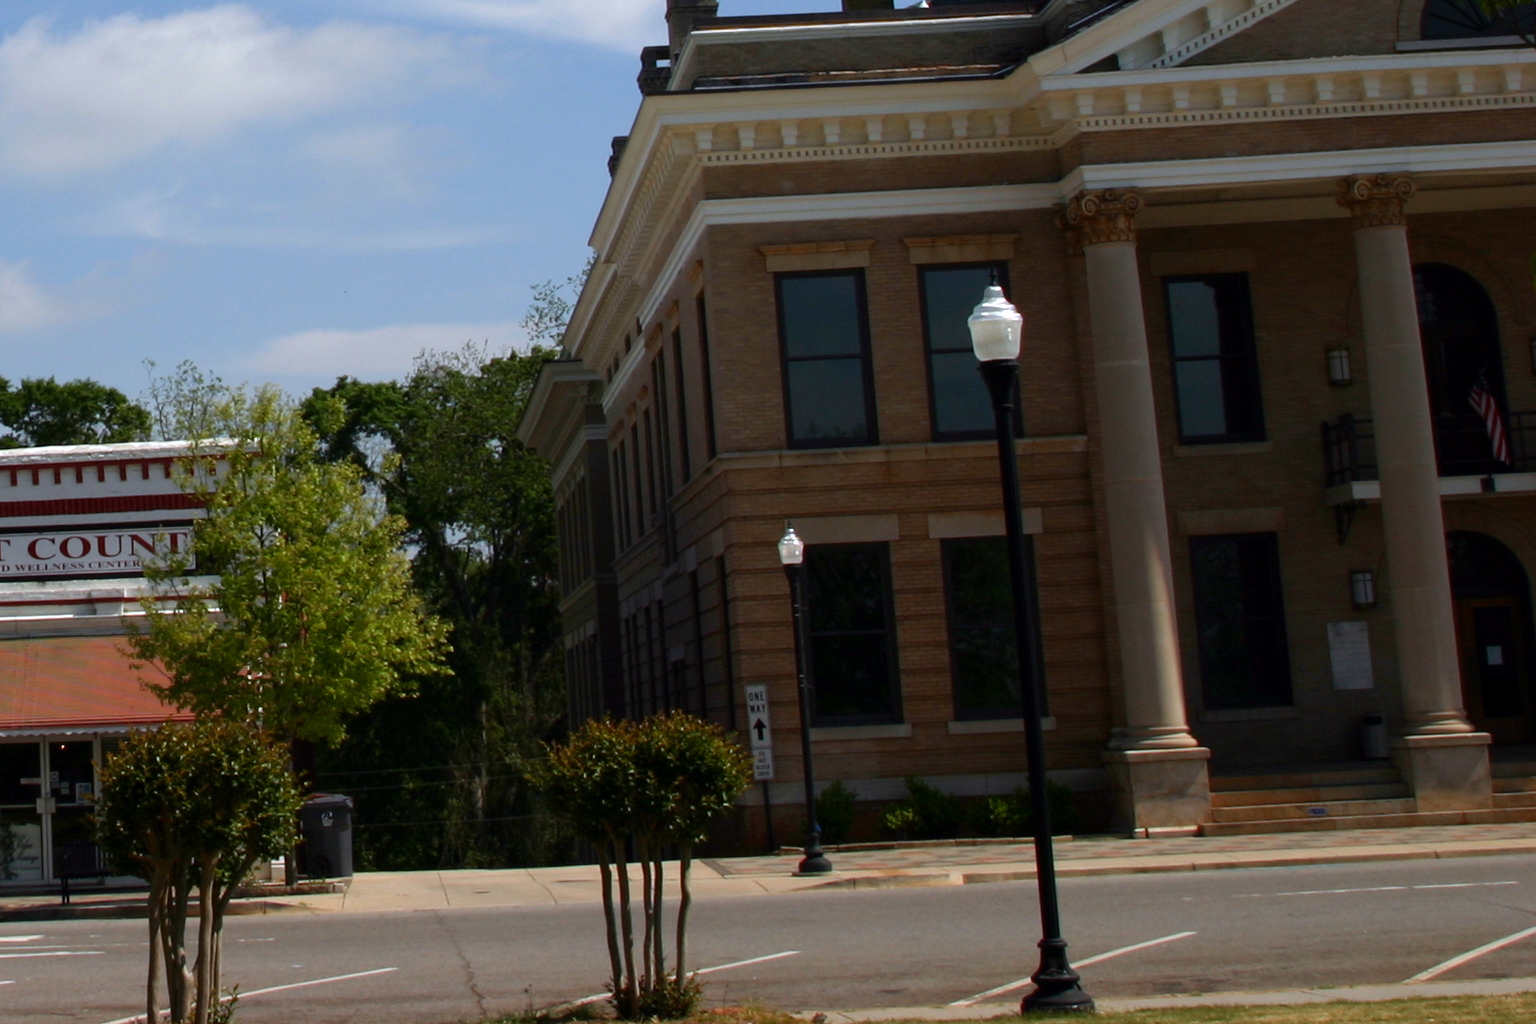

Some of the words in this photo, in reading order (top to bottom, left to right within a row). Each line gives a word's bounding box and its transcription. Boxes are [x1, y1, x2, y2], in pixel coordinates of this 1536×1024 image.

[27, 532, 188, 561] COUNT
[15, 562, 85, 572] WELLNESS
[88, 559, 140, 569] CENTER
[748, 692, 765, 702] ONE
[750, 705, 766, 714] WAY
